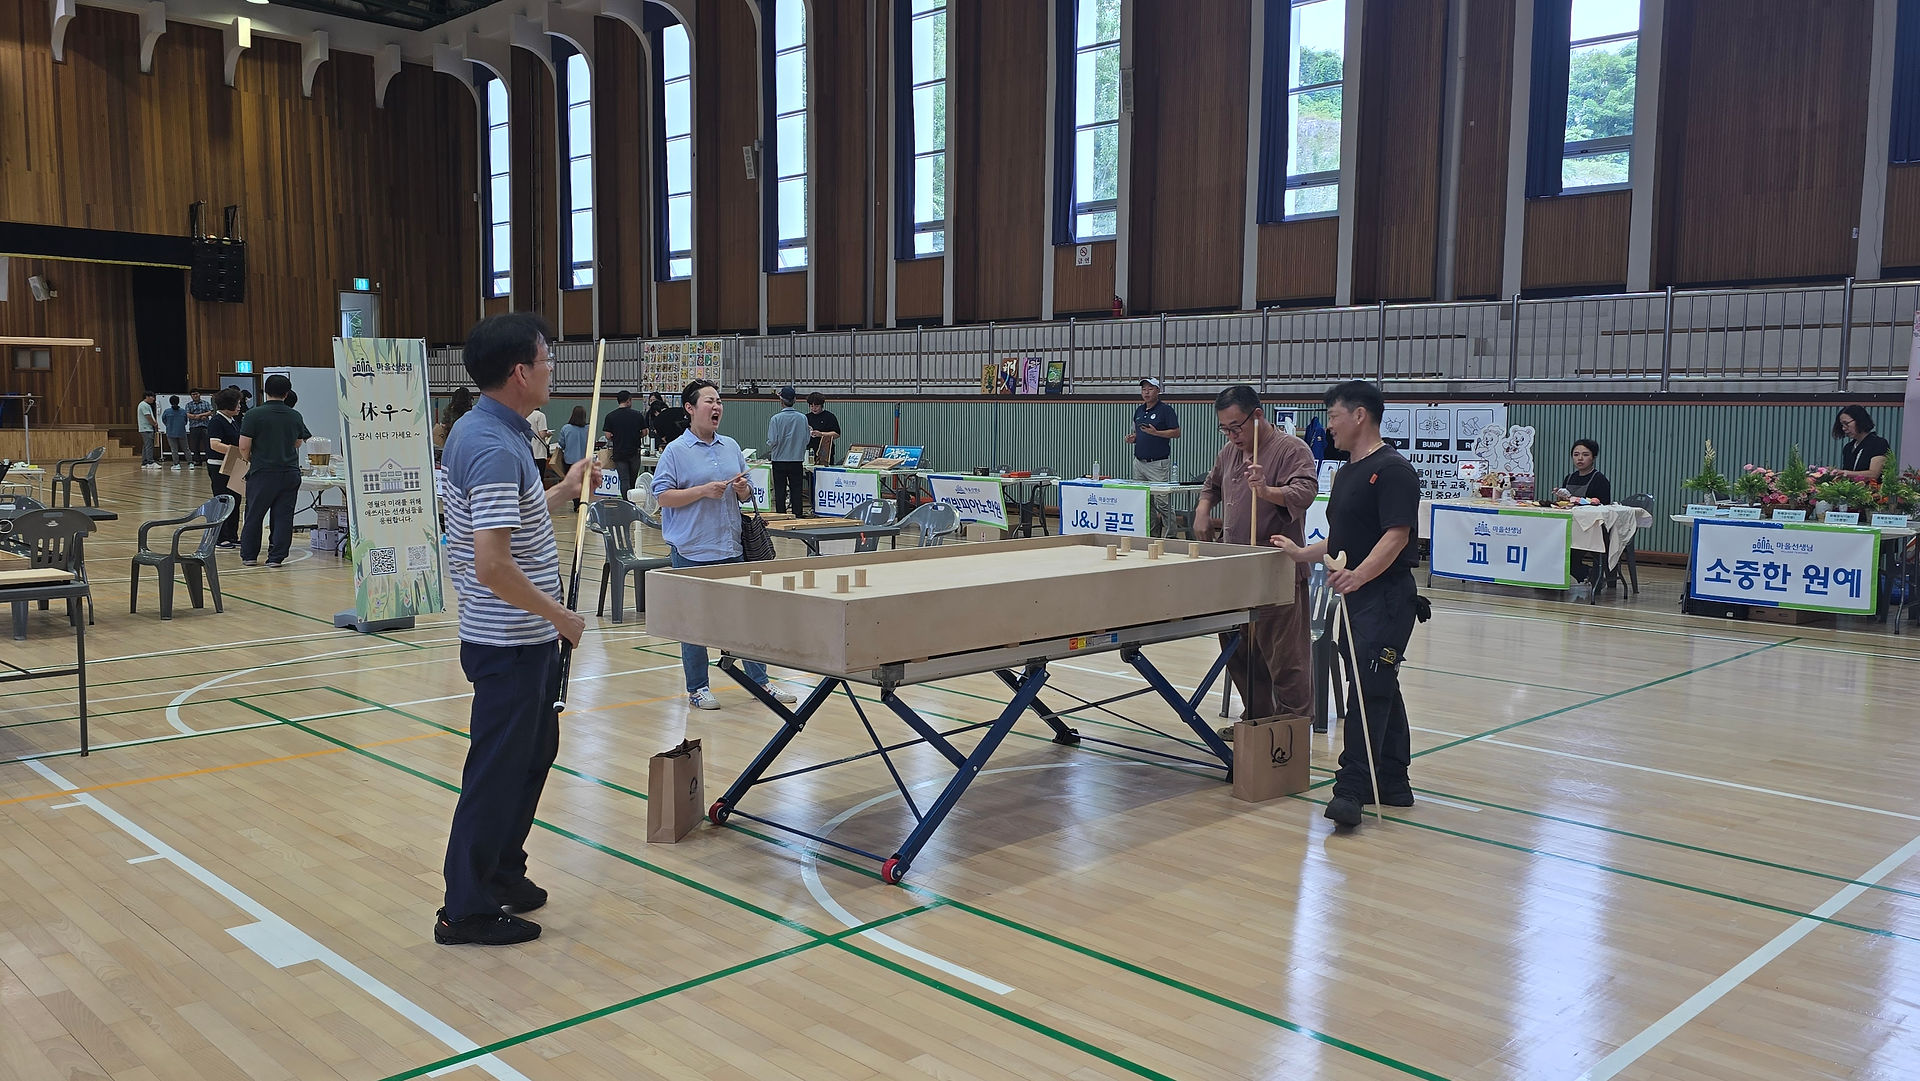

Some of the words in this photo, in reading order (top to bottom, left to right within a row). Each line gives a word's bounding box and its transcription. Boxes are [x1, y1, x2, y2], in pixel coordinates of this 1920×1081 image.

[376, 362, 413, 372] 마을선생님
[375, 431, 389, 440] 쉬다
[391, 430, 412, 440] 가세요
[1422, 441, 1443, 449] BUMP
[1409, 453, 1424, 463] JIU
[1426, 454, 1458, 464] JITSU
[1430, 480, 1447, 490] 필수
[367, 499, 386, 508] 영월의
[388, 498, 407, 507] 미래를
[364, 508, 391, 517] 애쓰시는
[392, 506, 424, 516] 선생님들을
[1071, 509, 1099, 530] J&J
[1104, 511, 1135, 533] 골프
[1492, 525, 1522, 535] 마을선생님
[1776, 541, 1814, 552] 마을선생님
[1704, 557, 1792, 593] 소중한
[1802, 563, 1863, 599] 원예
